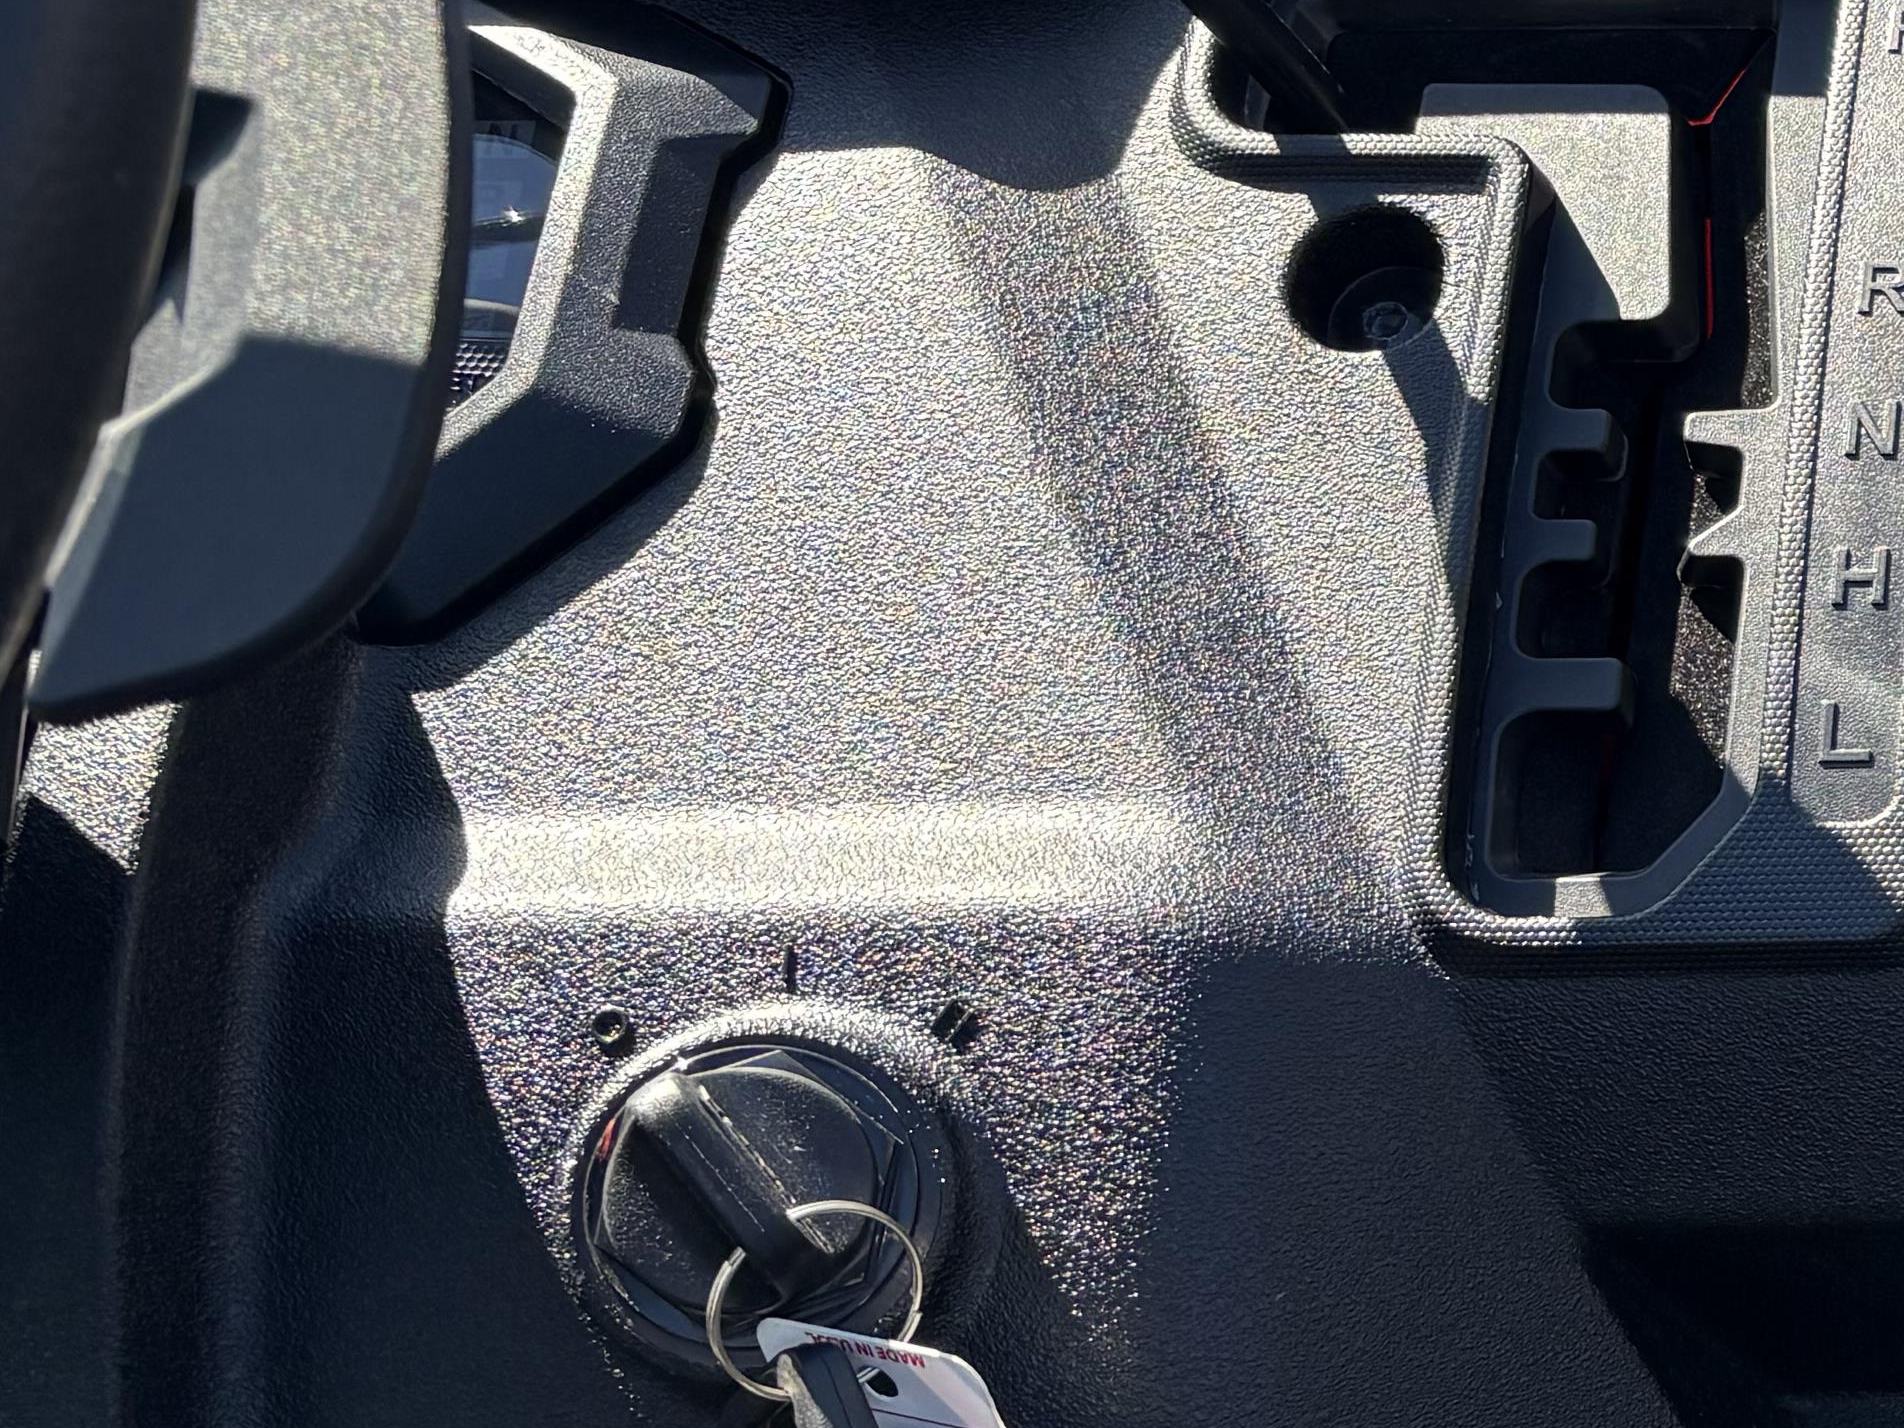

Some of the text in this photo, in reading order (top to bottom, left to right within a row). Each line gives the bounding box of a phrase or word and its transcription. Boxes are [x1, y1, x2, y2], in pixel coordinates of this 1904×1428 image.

[1844, 399, 1901, 460] N
[1832, 544, 1890, 609] H
[1819, 699, 1875, 768] L
[855, 1341, 875, 1358] IN
[877, 1346, 926, 1368] MADE
